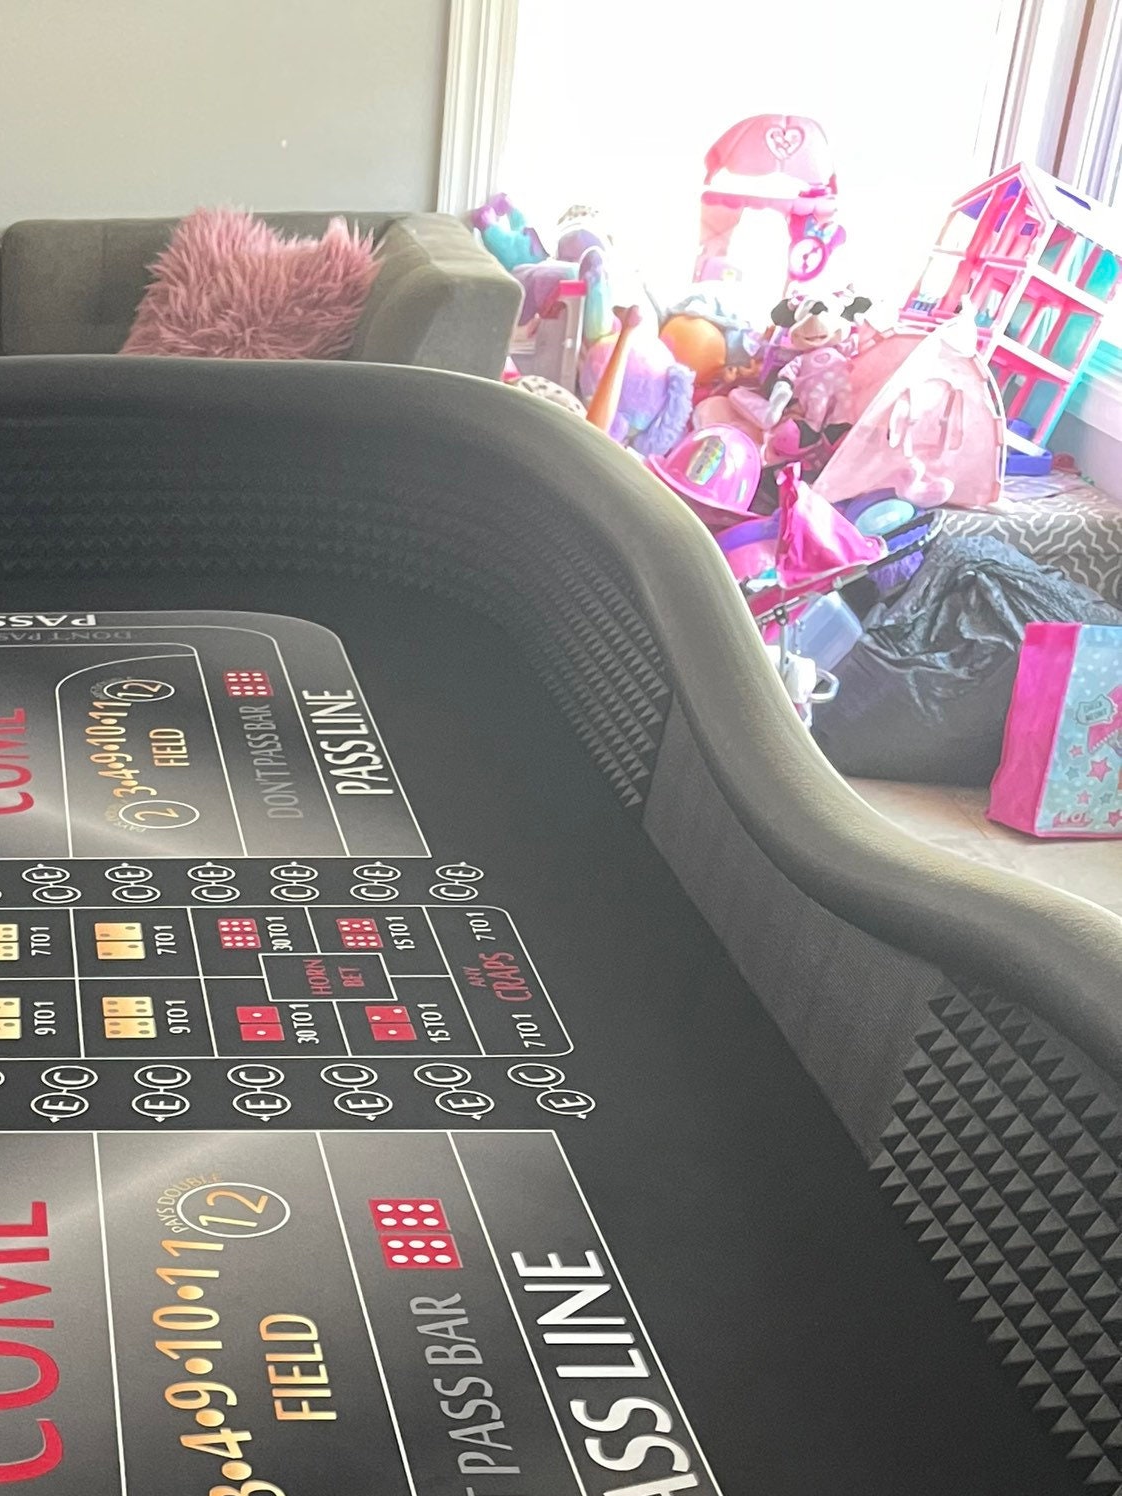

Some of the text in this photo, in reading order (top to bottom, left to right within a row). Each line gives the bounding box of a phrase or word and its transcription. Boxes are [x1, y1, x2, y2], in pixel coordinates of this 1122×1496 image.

[117, 682, 163, 698] 12
[148, 728, 190, 767] FIELD
[239, 704, 304, 818] DON'T PASS BAR
[302, 689, 395, 795] PASS LINE
[134, 808, 181, 822] 2
[303, 959, 333, 996] HORN
[338, 966, 365, 988] BET
[479, 952, 533, 1001] CRAPS
[156, 1208, 190, 1234] PAYS
[198, 1189, 269, 1228] 12
[409, 1293, 484, 1365] BAR
[511, 1250, 652, 1378] LINE
[259, 1313, 338, 1421] FIELD
[433, 1376, 522, 1474] PASS
